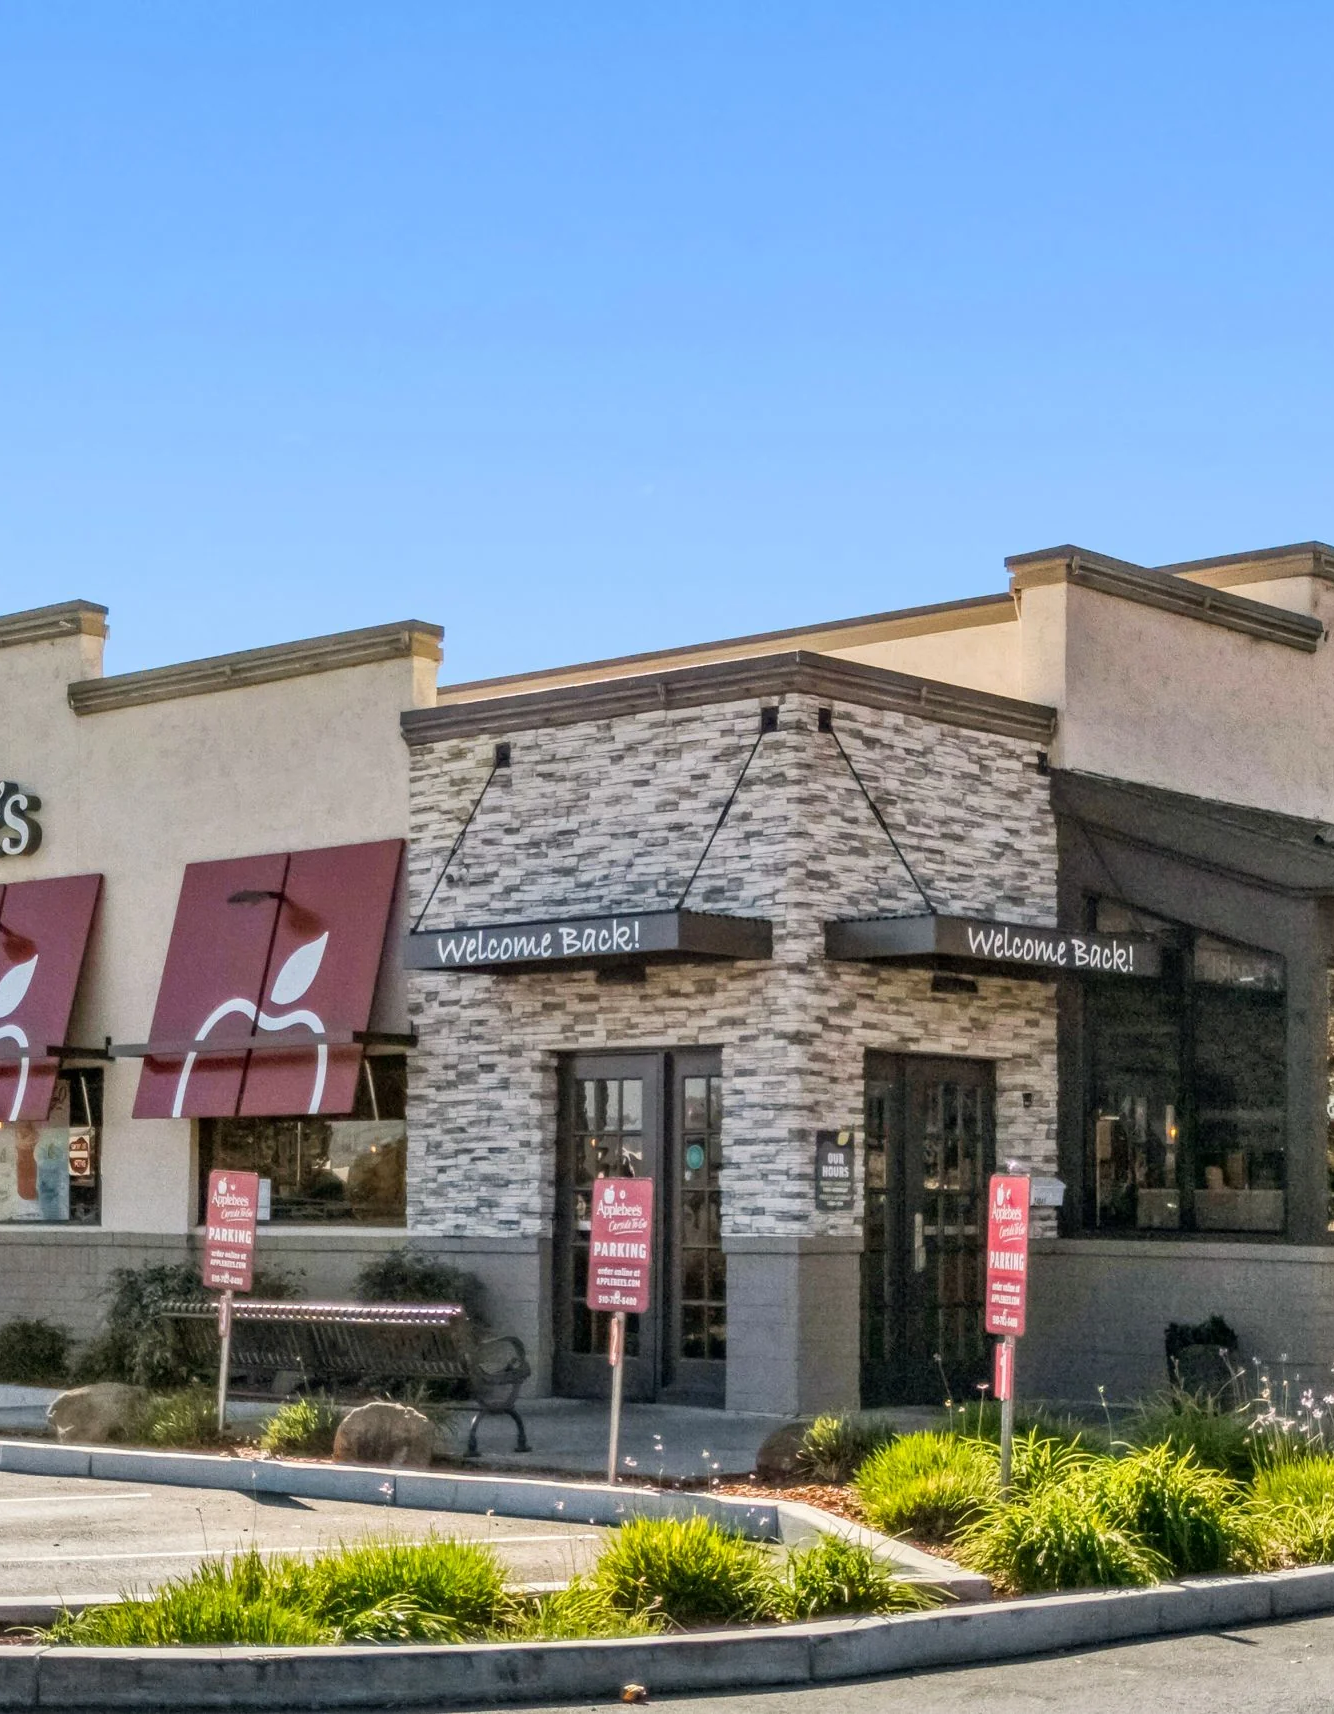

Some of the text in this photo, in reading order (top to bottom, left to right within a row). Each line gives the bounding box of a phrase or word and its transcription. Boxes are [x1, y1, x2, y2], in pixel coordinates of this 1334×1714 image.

[437, 919, 640, 963] Welcome Back!
[967, 927, 1133, 973] Welcome Back!
[827, 1152, 845, 1165] OUR
[822, 1165, 850, 1178] HOURS
[211, 1190, 249, 1208] Applebee's
[596, 1199, 643, 1218] Applebee's
[208, 1227, 252, 1244] PARKING
[593, 1241, 647, 1259] PARKING
[989, 1250, 1024, 1271] PARKING
